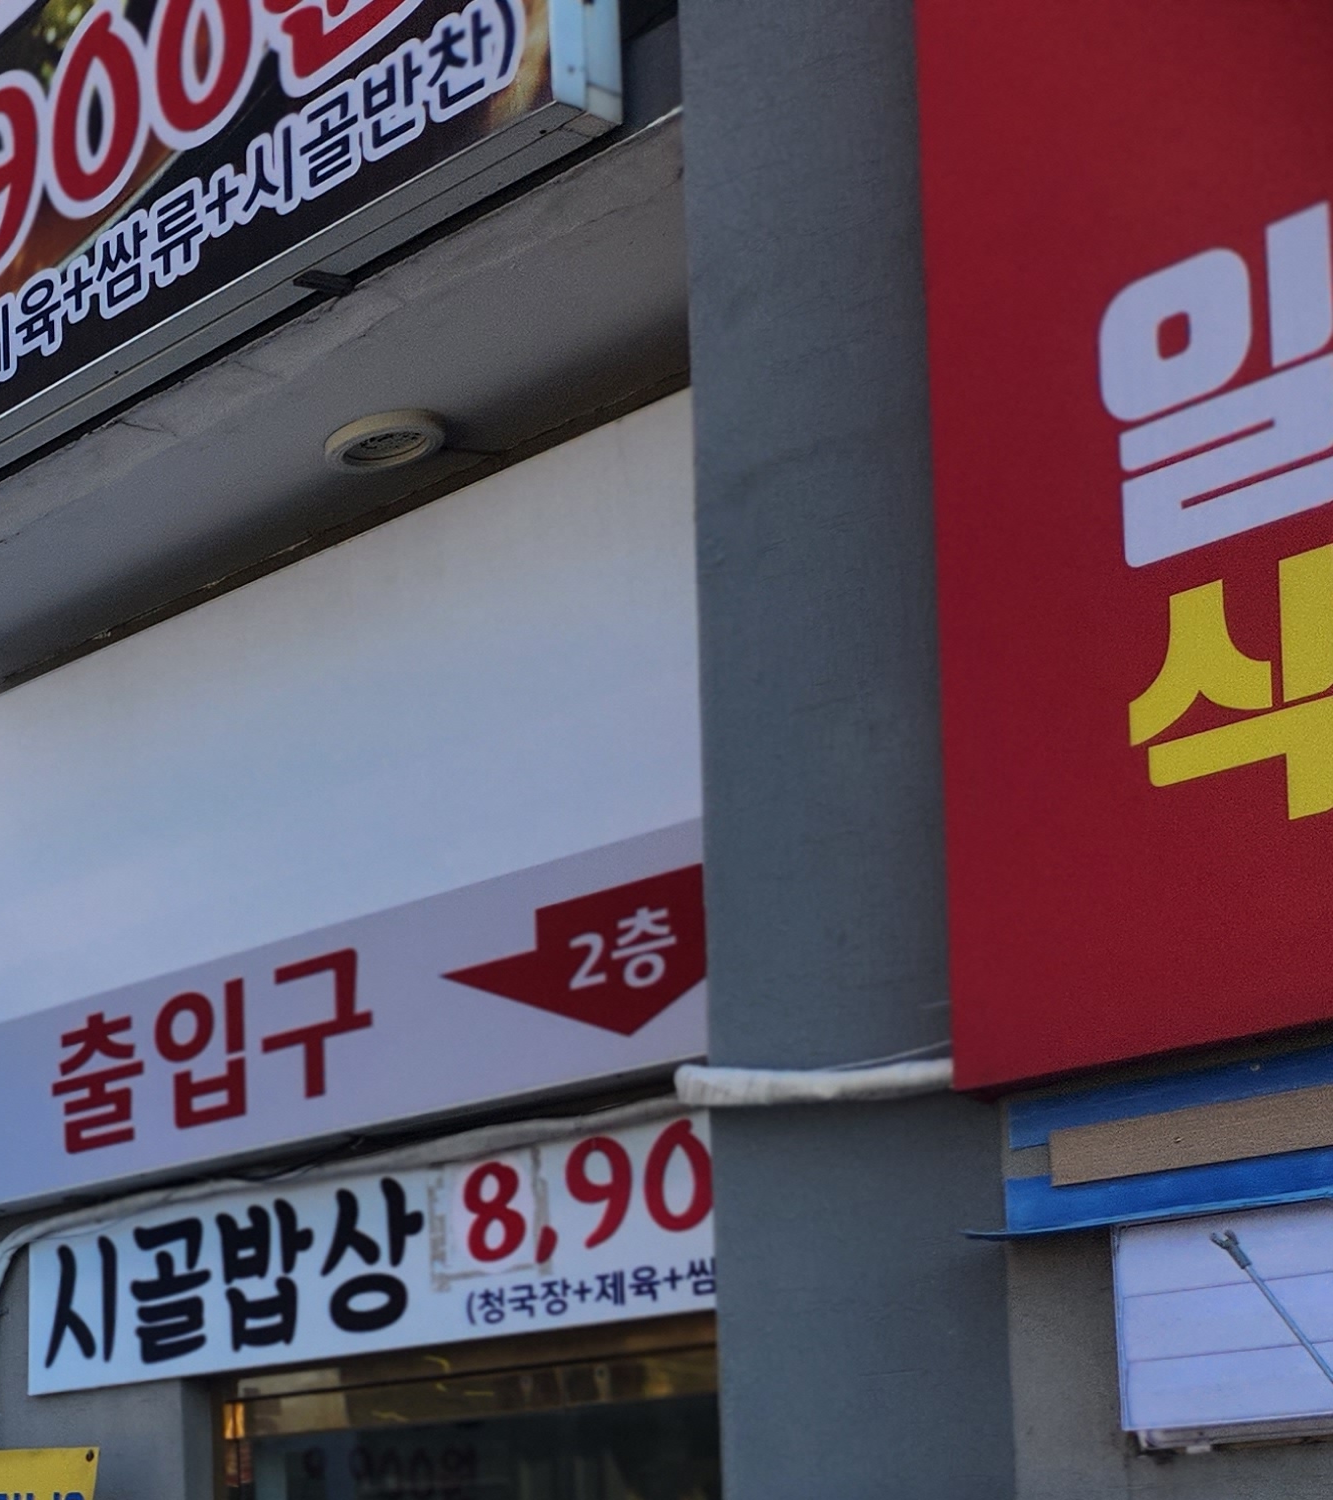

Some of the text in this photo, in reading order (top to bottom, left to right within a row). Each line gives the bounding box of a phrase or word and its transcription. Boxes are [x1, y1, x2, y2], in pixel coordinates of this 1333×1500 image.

[567, 905, 679, 991] 2층
[51, 947, 374, 1155] 출입구
[44, 1176, 425, 1370] 시골밥상
